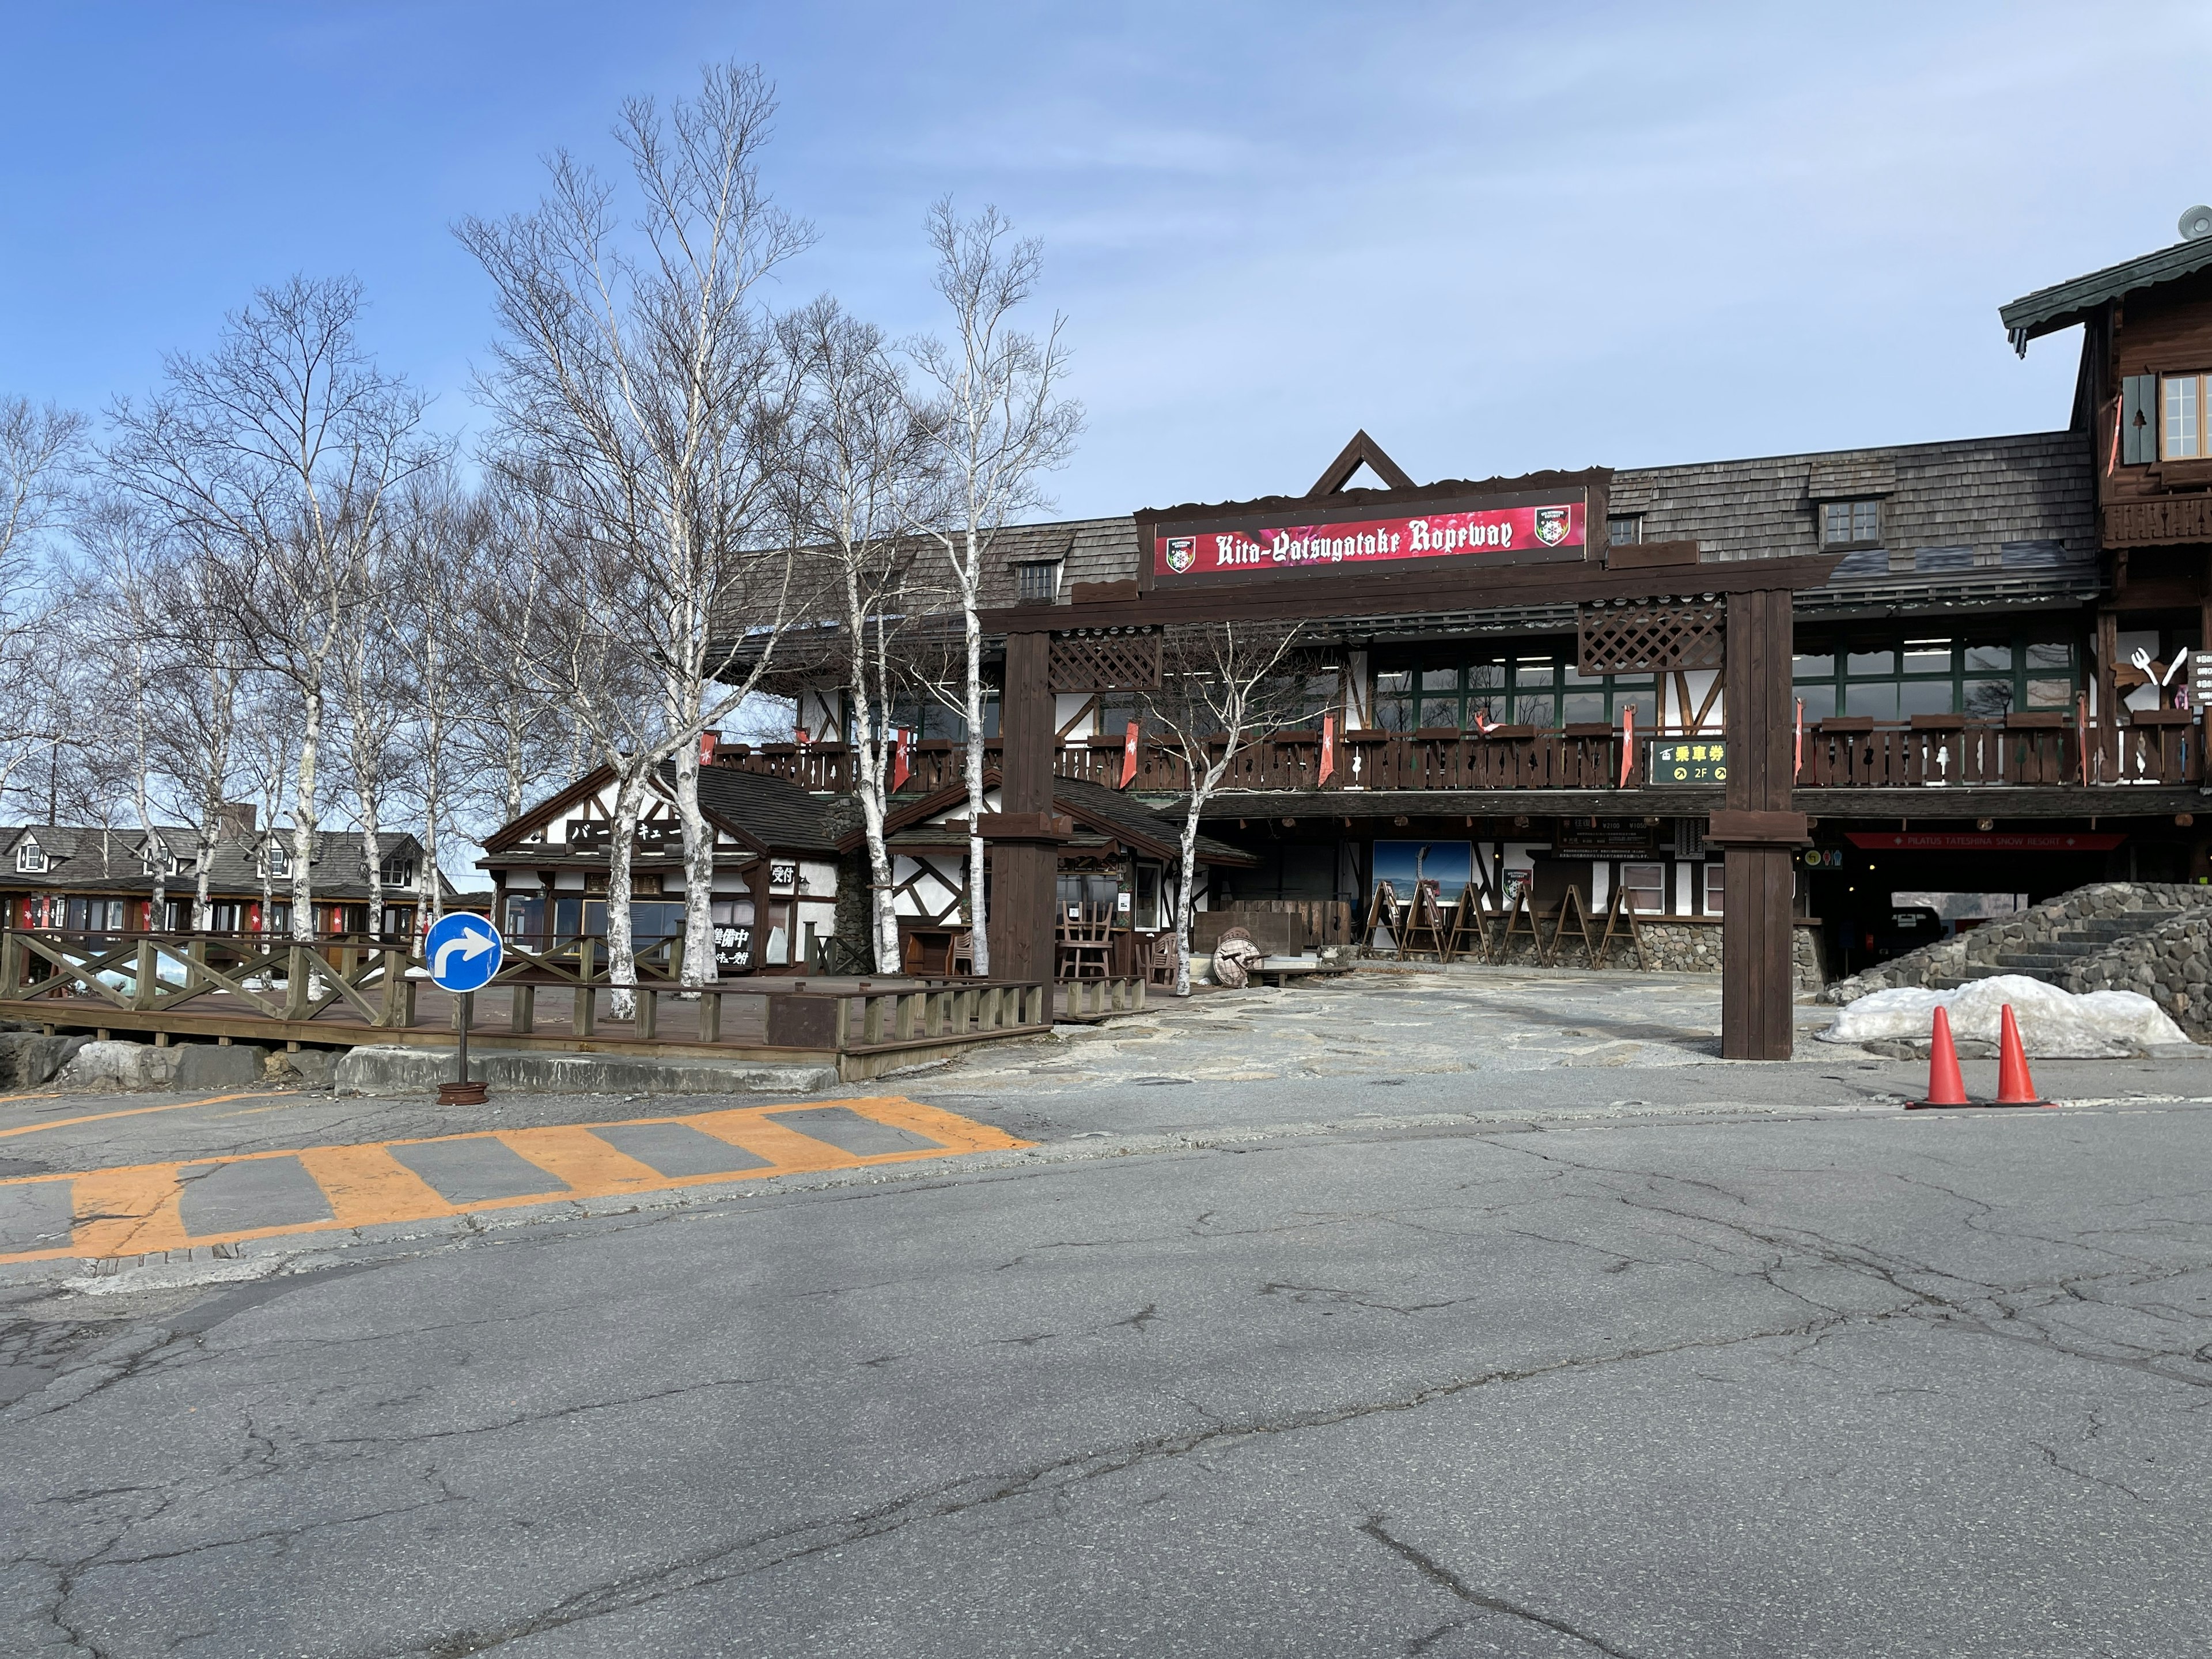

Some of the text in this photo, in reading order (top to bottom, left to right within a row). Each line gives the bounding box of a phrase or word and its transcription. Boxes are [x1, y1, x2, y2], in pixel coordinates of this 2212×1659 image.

[1215, 520, 1513, 566] Kita-Yatsugatake Ropeway
[1675, 745, 1724, 762] 乗車券
[1695, 768, 1707, 778] 2F
[571, 823, 681, 840] バーキュー
[1907, 837, 2061, 846] PILATUS TATESHINA SNOW RESORT
[772, 866, 794, 882] 受付
